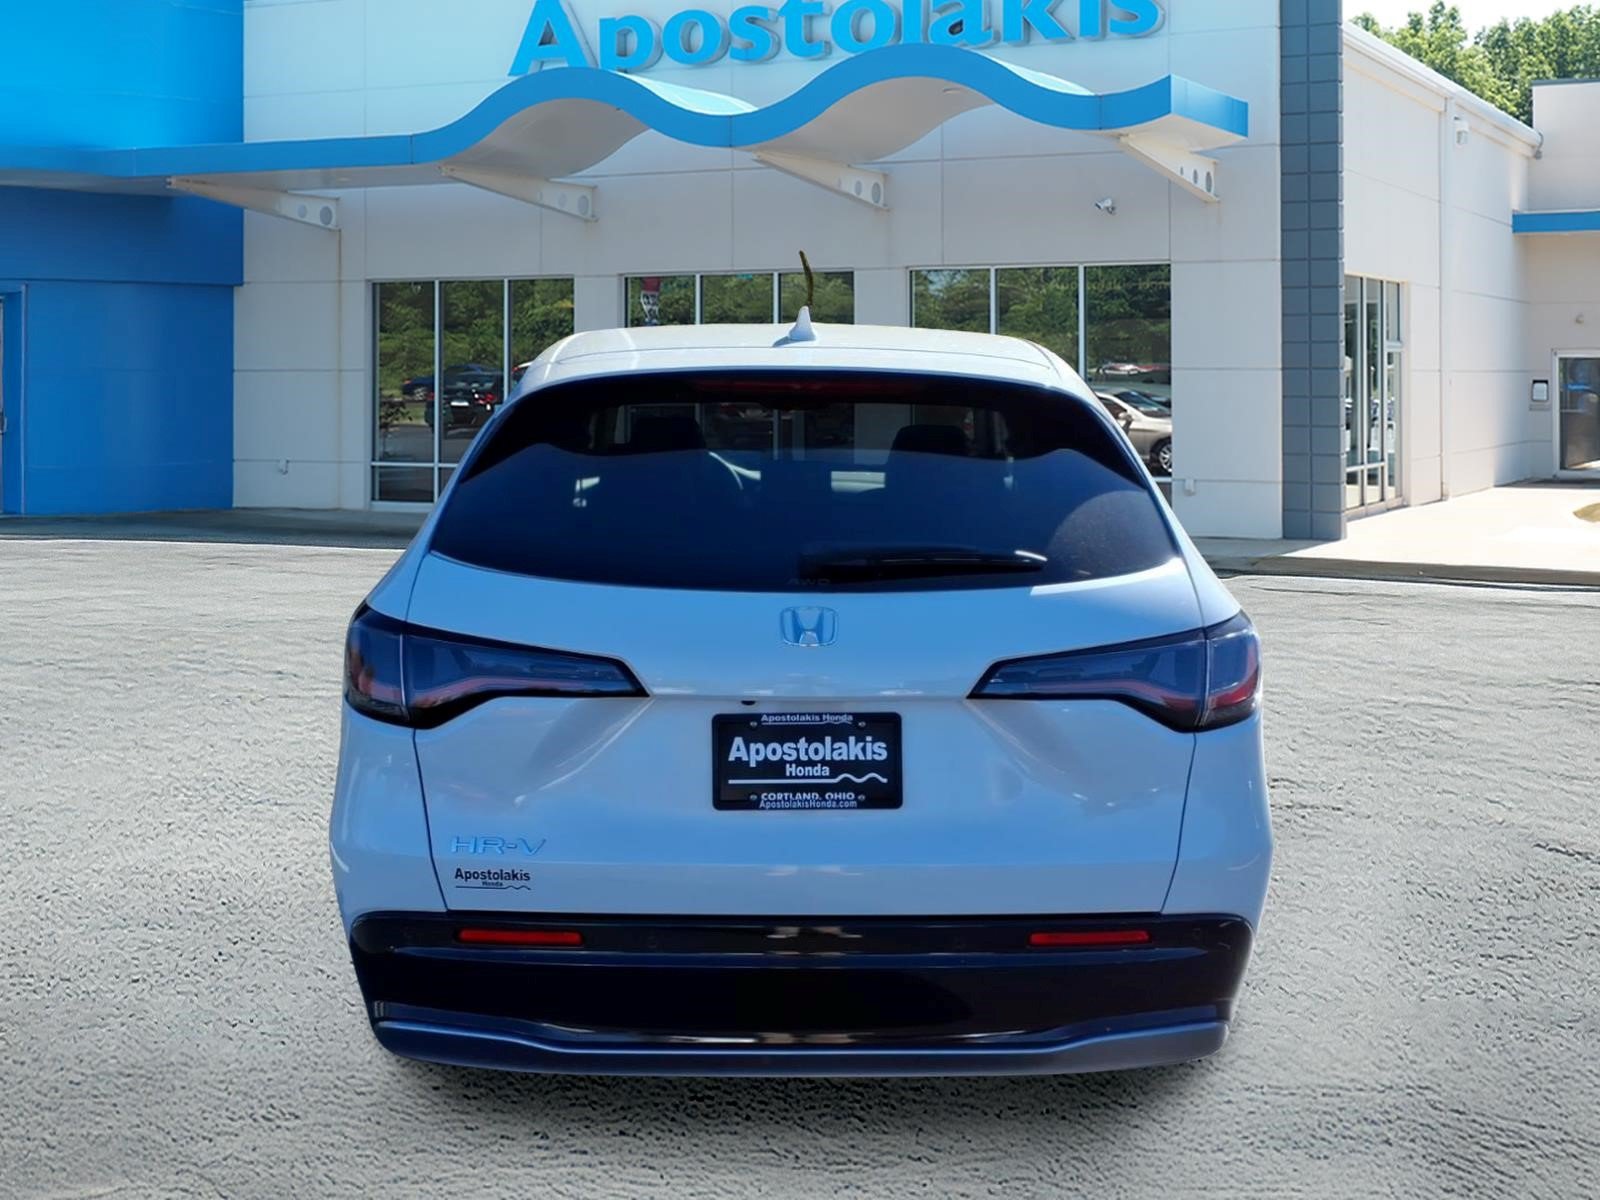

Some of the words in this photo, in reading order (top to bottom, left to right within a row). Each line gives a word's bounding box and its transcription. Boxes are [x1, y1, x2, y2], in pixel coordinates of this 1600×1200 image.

[761, 714, 820, 722] Apostolakis
[822, 713, 853, 721] Honda
[728, 736, 888, 767] Apostolakis
[785, 763, 830, 777] Honda
[825, 792, 855, 800] OHIO
[759, 800, 857, 809] ApostolakisHonda.com
[451, 837, 547, 855] HR-V
[455, 868, 530, 882] Apostolakis
